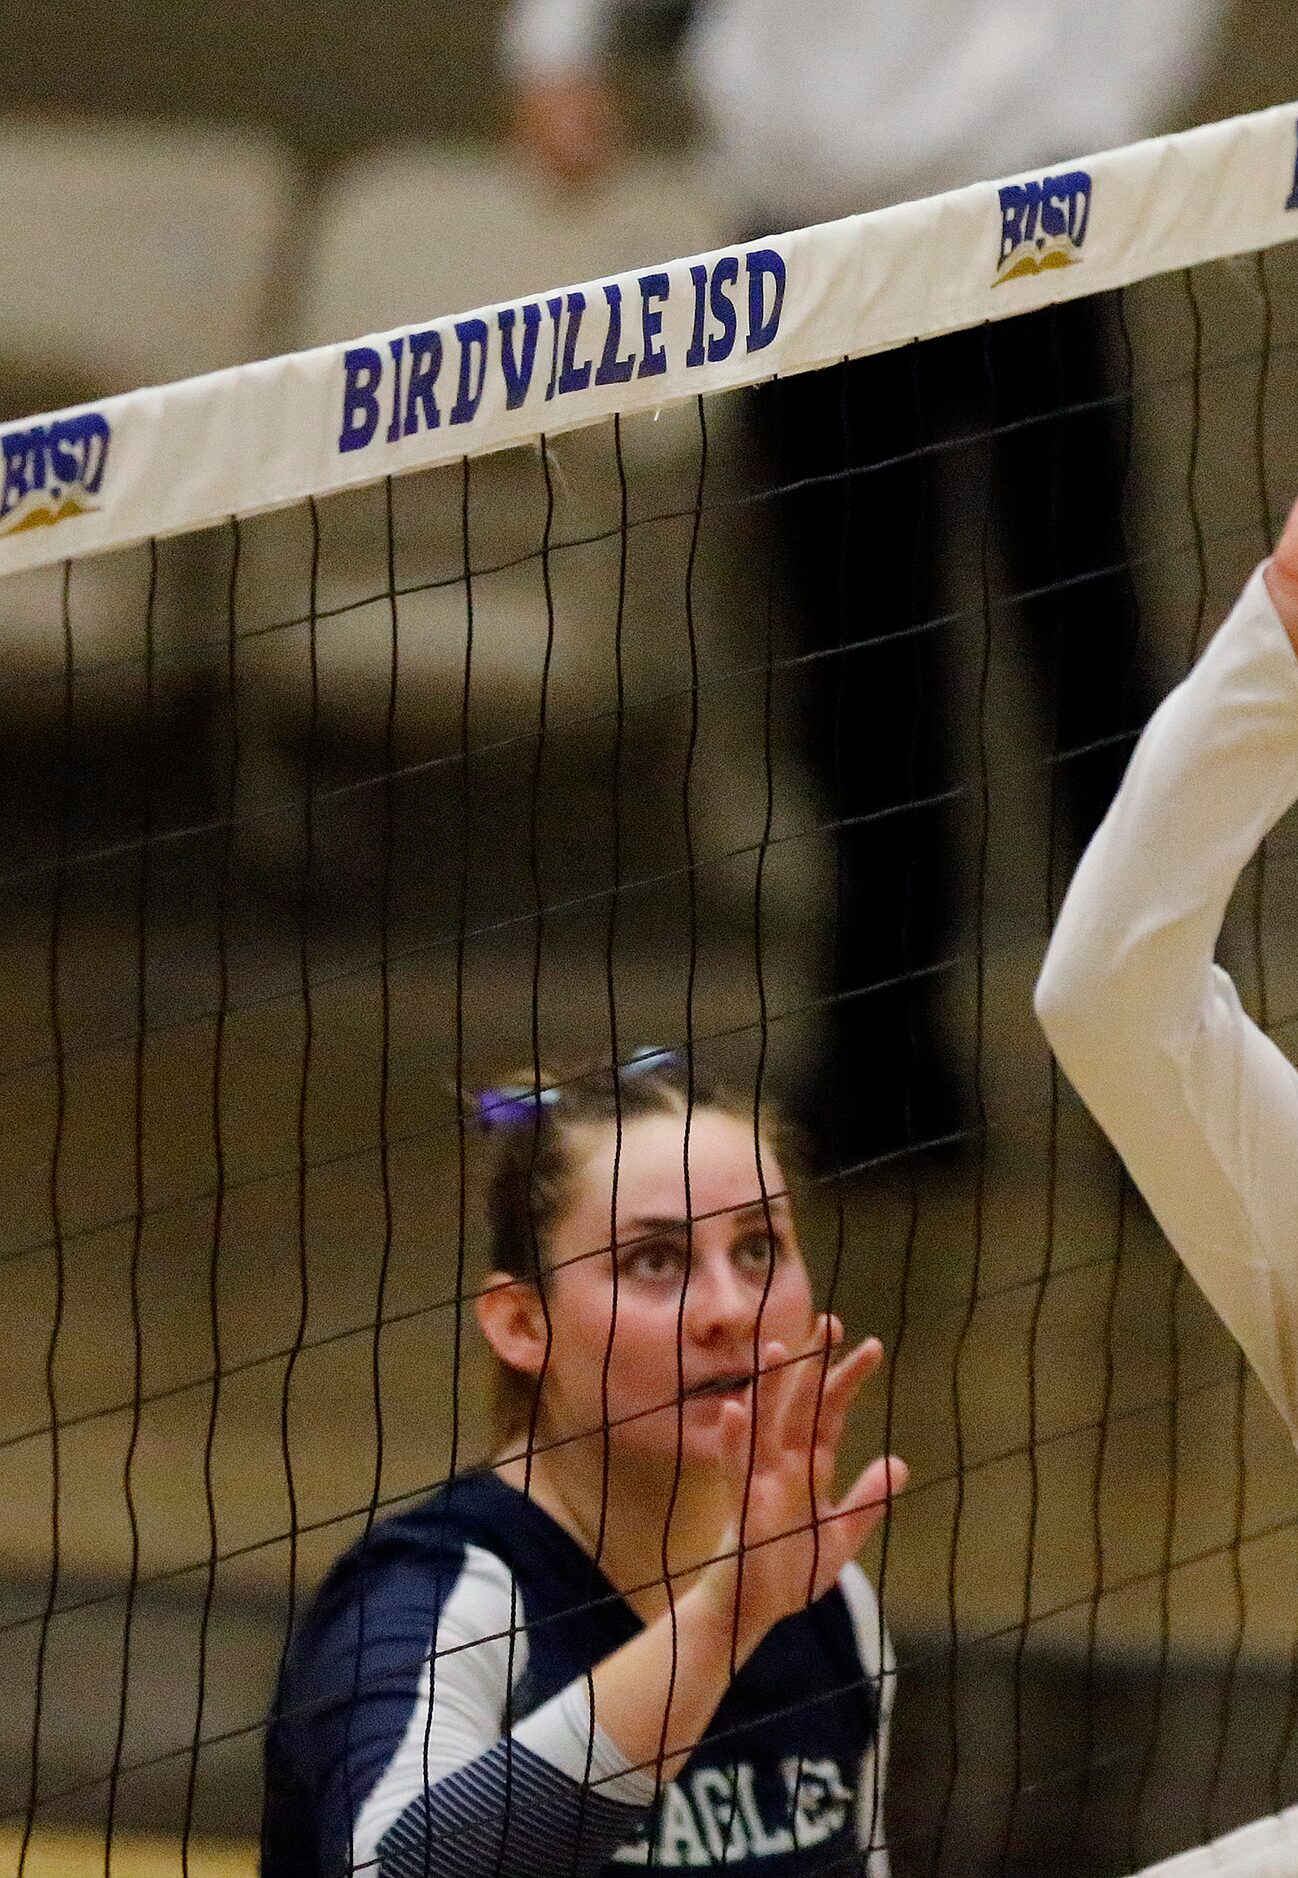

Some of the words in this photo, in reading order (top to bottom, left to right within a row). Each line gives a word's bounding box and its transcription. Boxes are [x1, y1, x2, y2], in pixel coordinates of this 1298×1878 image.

[339, 272, 669, 453] BIRDVILLE
[686, 249, 787, 368] ISD
[611, 1755, 852, 1868] AGLE
